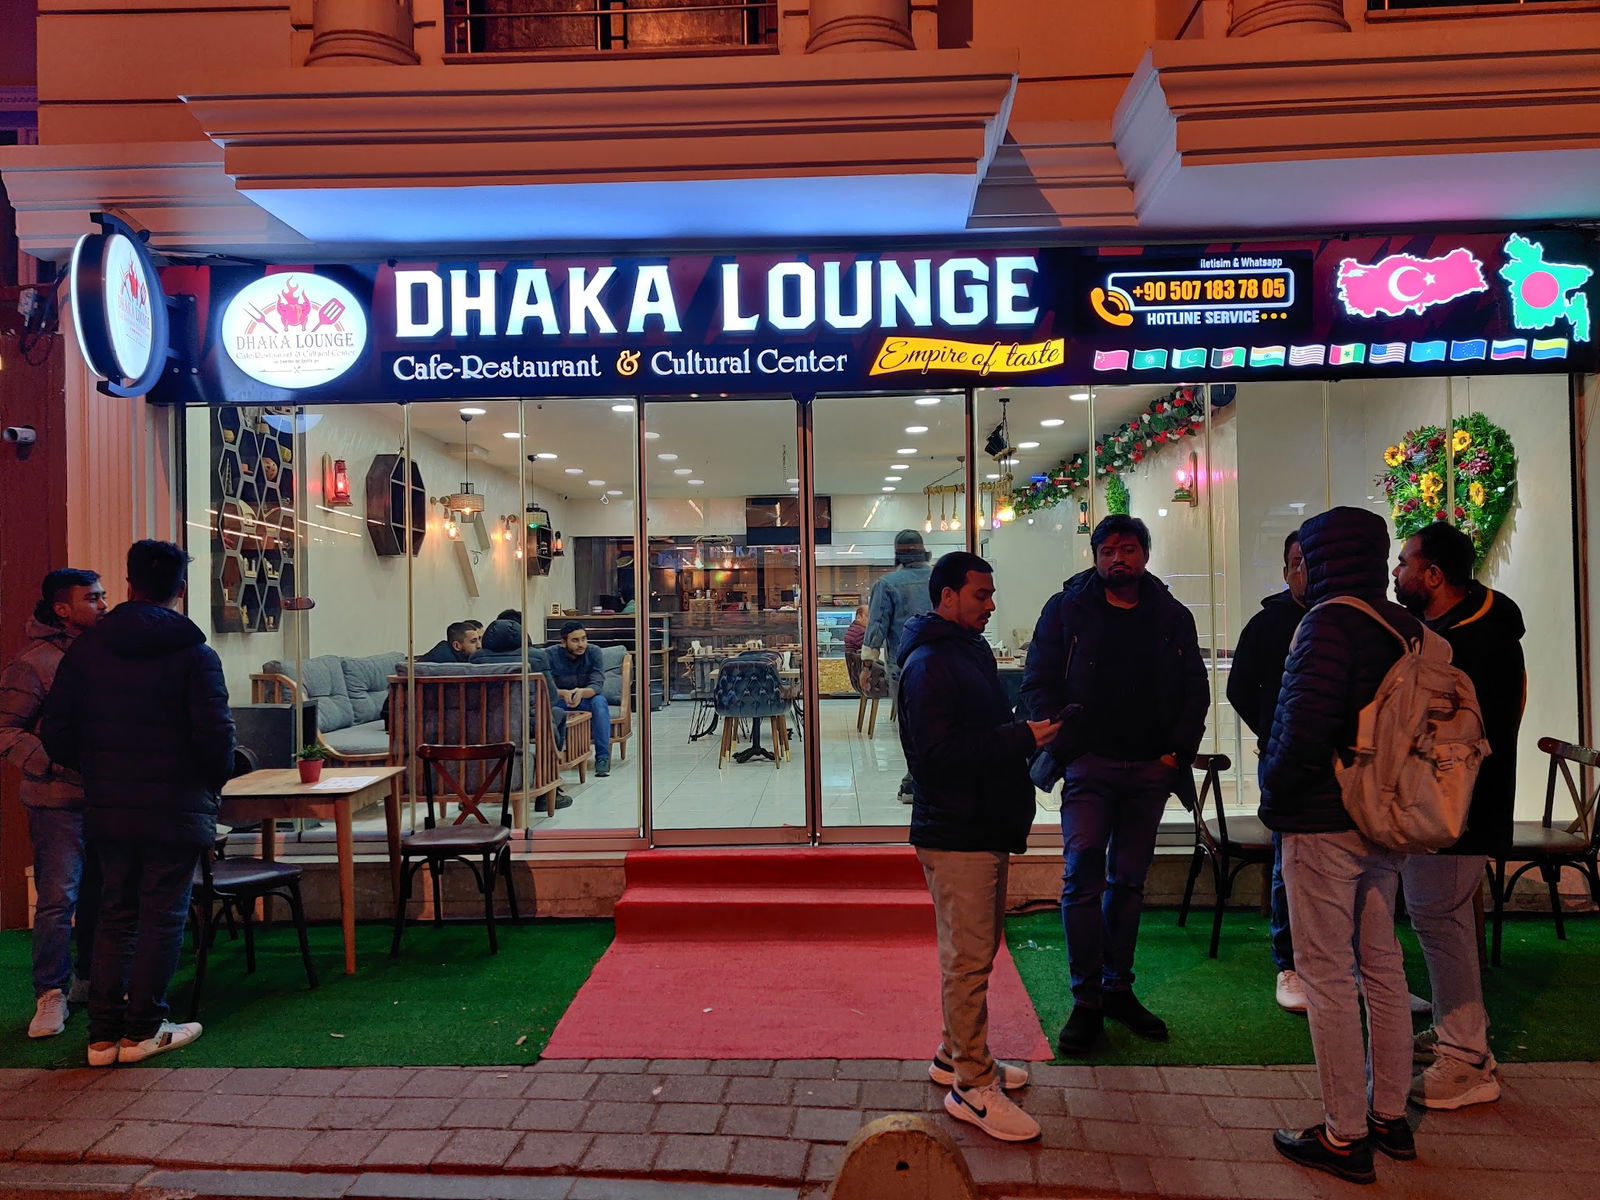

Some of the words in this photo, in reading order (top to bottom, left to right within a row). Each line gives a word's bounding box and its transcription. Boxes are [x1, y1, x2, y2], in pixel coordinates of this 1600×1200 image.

[1233, 257, 1240, 268] &
[1241, 257, 1283, 269] Whatsapp
[395, 265, 682, 337] DHAKA
[722, 256, 1039, 332] LOUNGE
[1132, 281, 1166, 301] +90
[1170, 280, 1201, 300] 507
[1204, 279, 1235, 300] 183
[1238, 278, 1259, 299] 78
[1262, 278, 1286, 298] 05
[1147, 311, 1202, 326] HOTLINE
[1205, 310, 1260, 325] SERVICE
[236, 335, 291, 351] DHAKA
[295, 332, 354, 349] LOUNGE
[393, 353, 602, 381] Cafe-Restaurant
[616, 350, 641, 377] &
[651, 348, 751, 376] Cultural
[757, 348, 848, 375] Center
[877, 339, 969, 375] Empire
[972, 340, 1001, 376] of
[1006, 340, 1060, 367] taste
